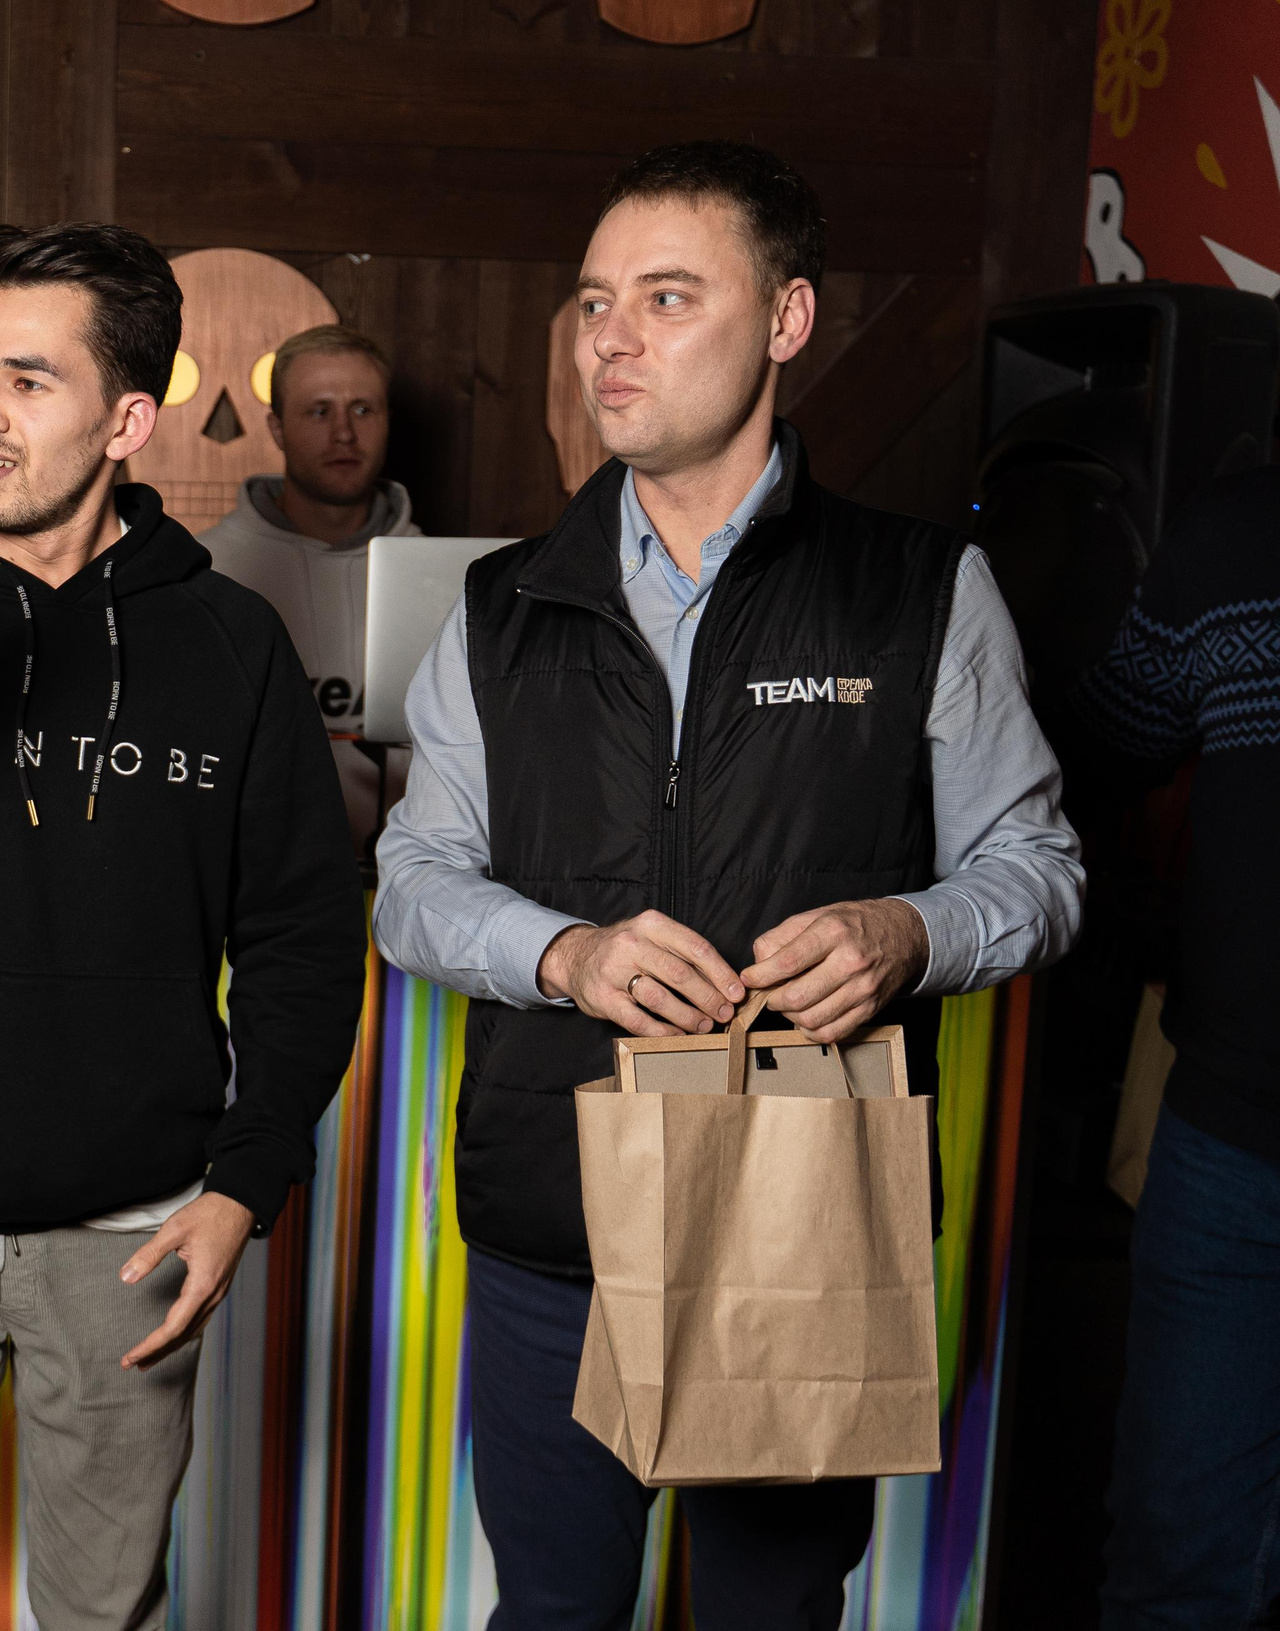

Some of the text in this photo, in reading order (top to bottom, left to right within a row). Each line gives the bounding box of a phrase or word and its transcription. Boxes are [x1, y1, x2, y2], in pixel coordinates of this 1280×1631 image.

[106, 607, 118, 646] BORN TO BE
[111, 681, 120, 700] BORN
[746, 677, 836, 706] TEAM
[837, 690, 866, 704] КОФЕ
[71, 736, 142, 775] TO
[167, 748, 220, 789] BE
[95, 754, 104, 773] BORN
